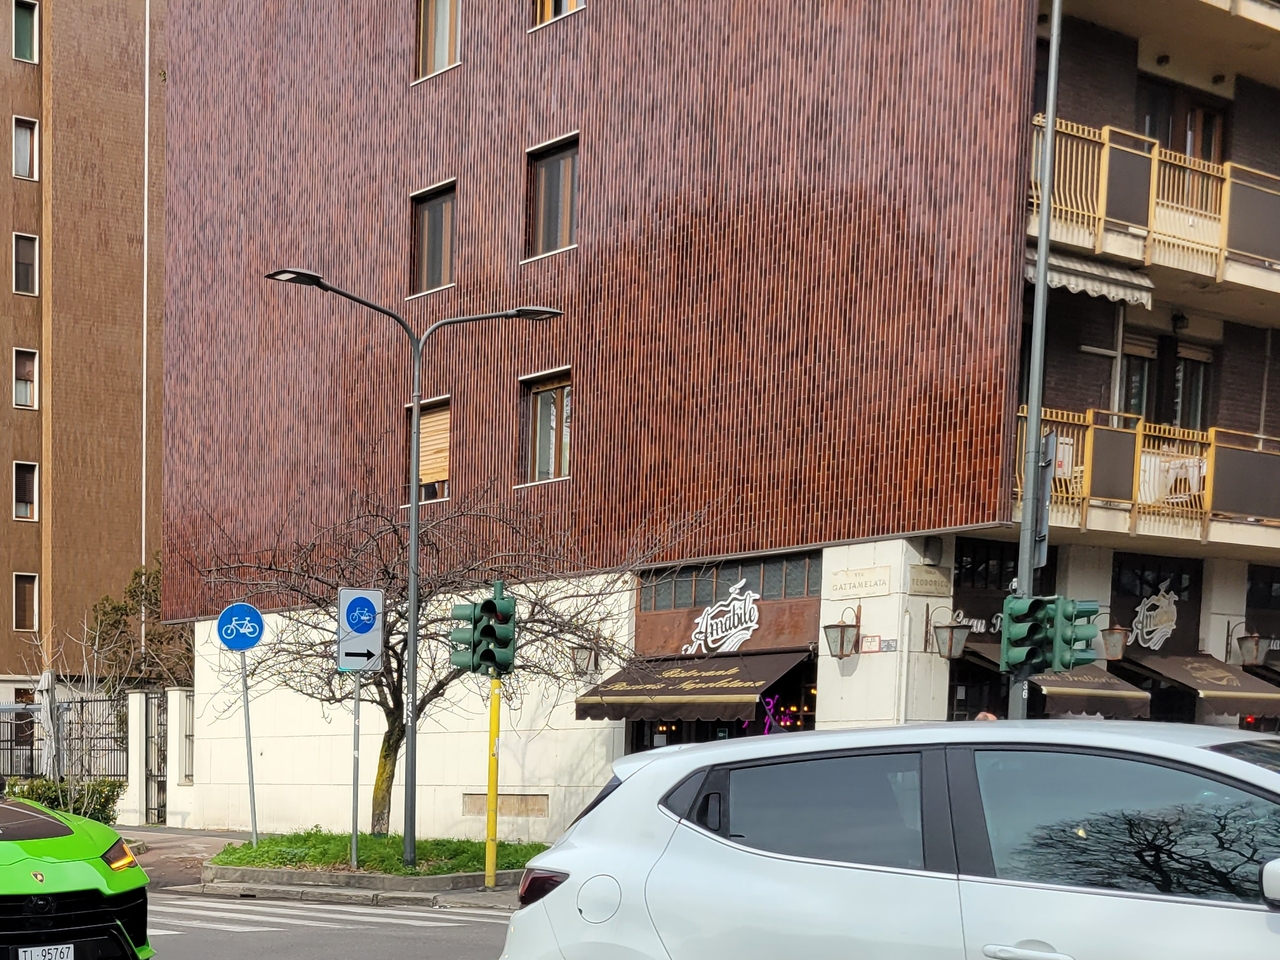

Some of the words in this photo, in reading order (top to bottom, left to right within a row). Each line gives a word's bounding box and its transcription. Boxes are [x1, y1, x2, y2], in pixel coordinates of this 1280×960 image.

[832, 579, 887, 592] GATTAMELATA
[911, 578, 949, 588] TEODORICO
[693, 591, 760, 652] Amabile
